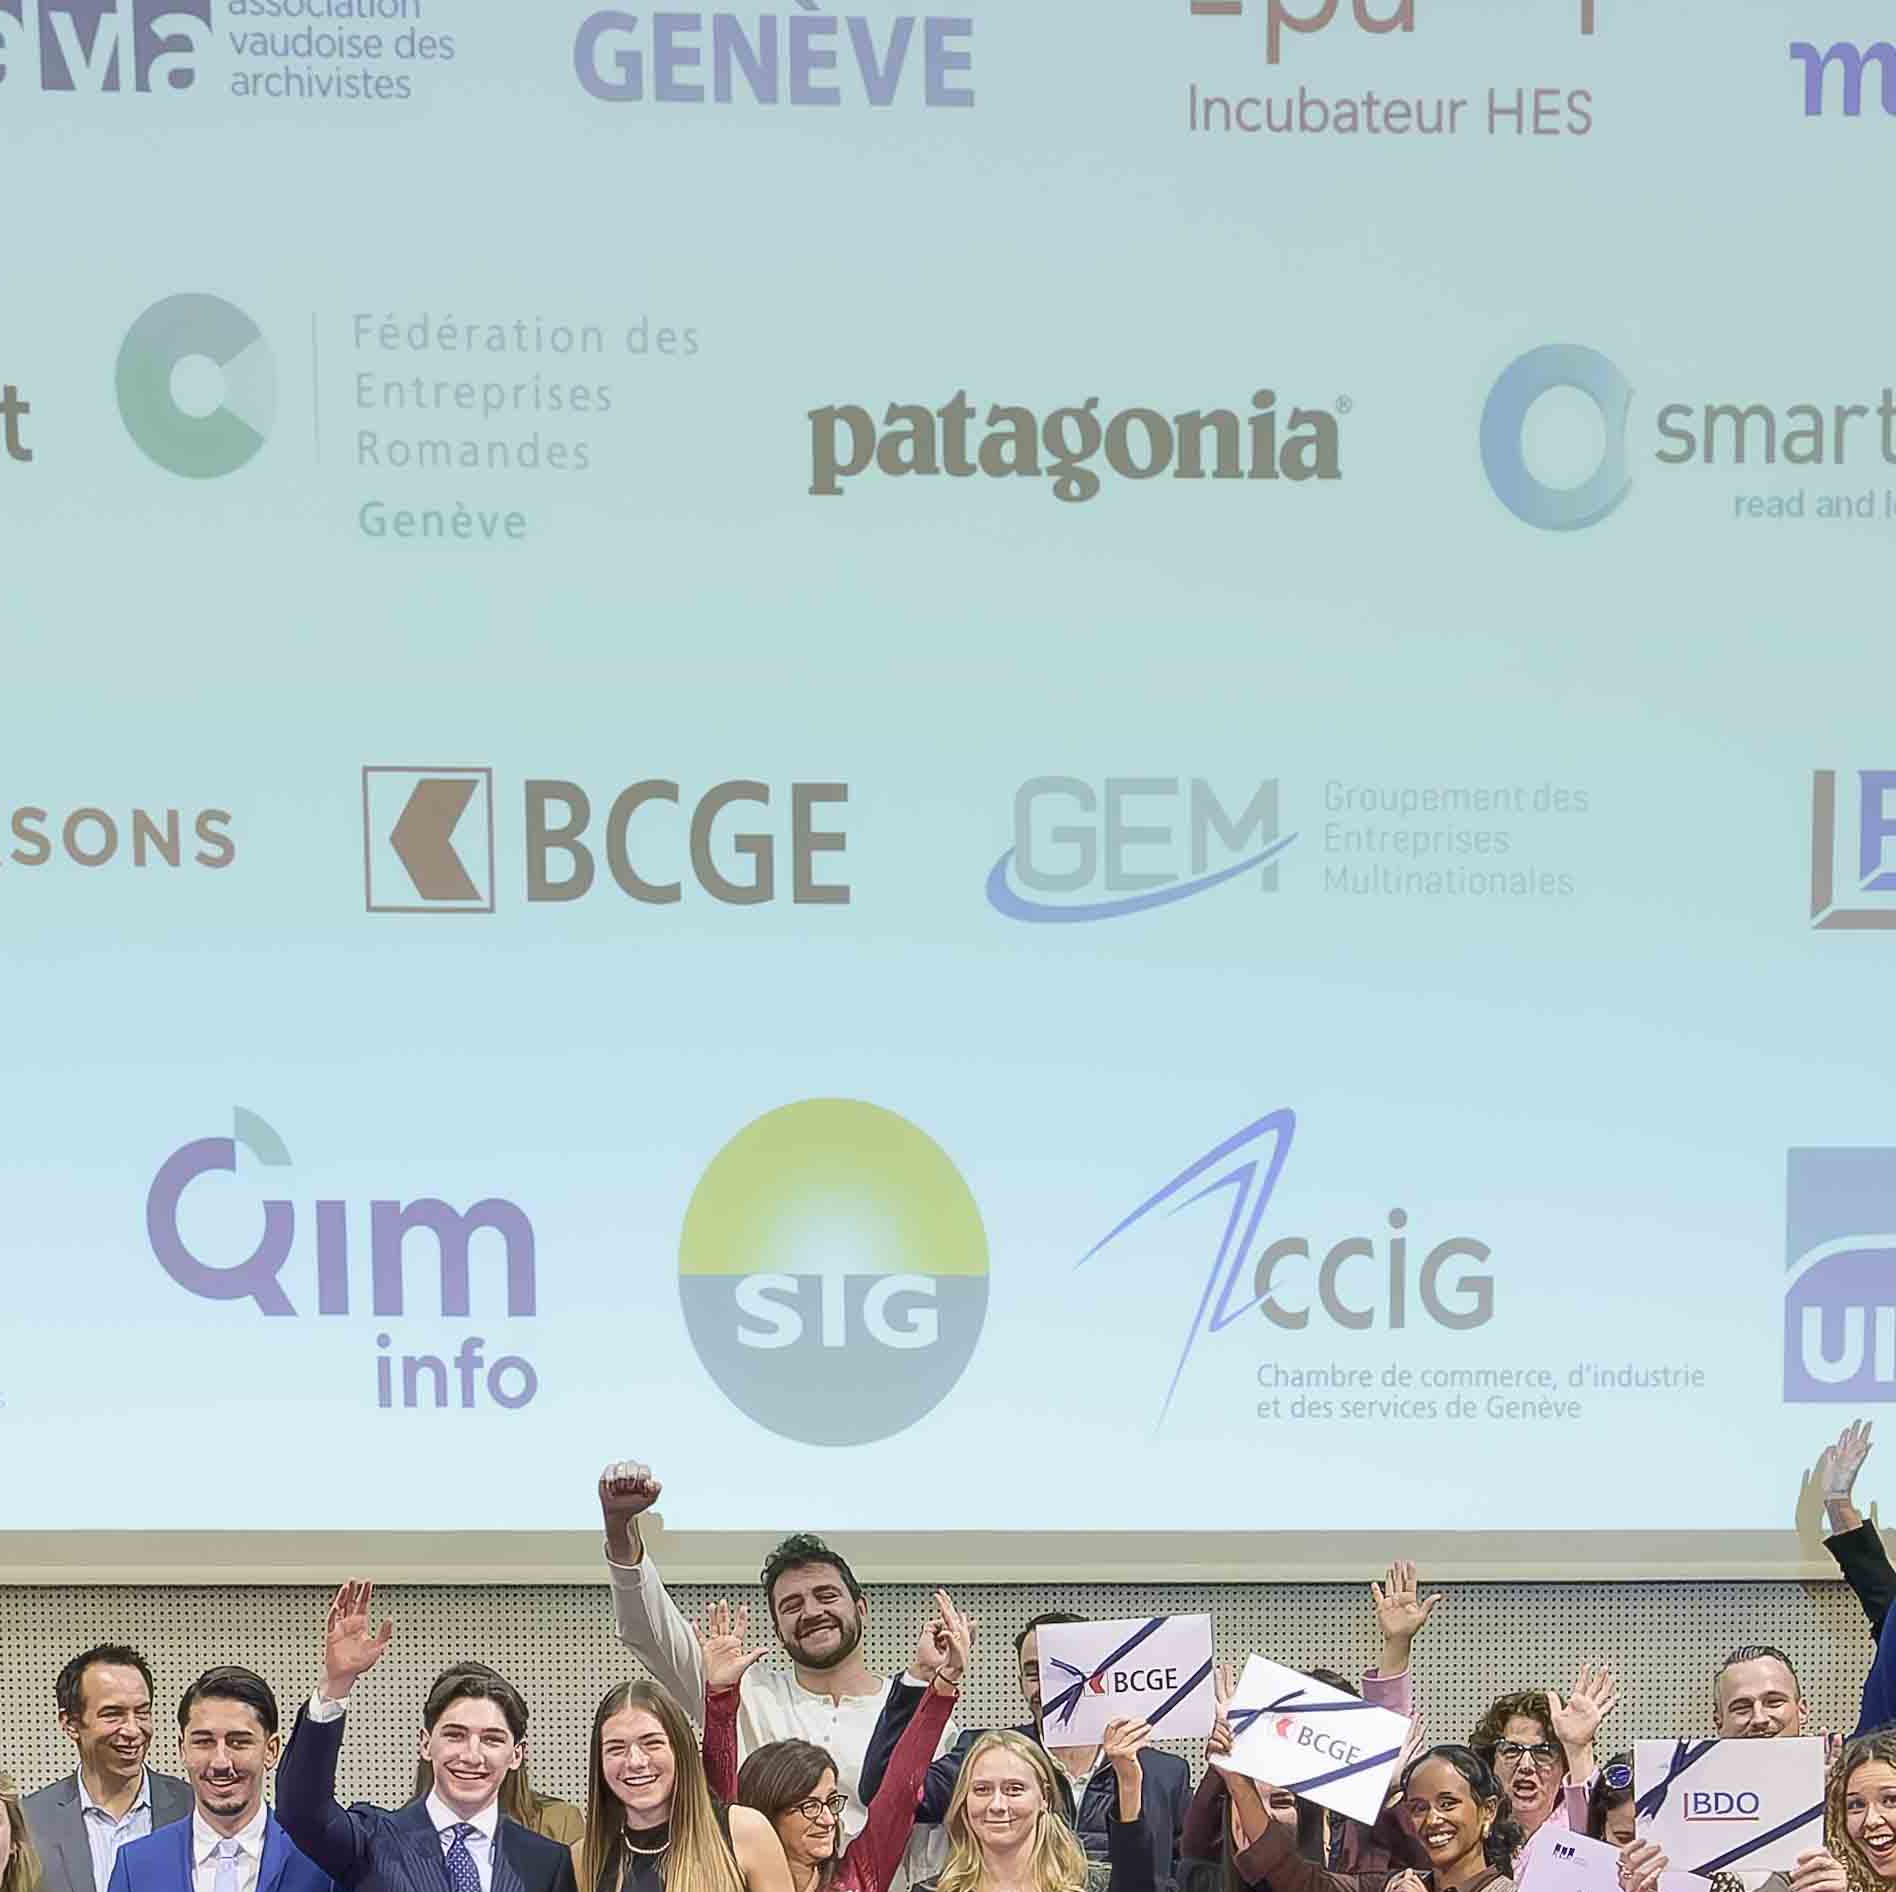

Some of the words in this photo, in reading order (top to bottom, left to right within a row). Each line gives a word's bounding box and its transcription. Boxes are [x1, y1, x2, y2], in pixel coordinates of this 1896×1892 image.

[230, 25, 384, 60] vaudoise
[394, 26, 456, 61] des
[230, 66, 412, 101] archivistes
[1189, 84, 1468, 136] Incubateur
[1487, 88, 1595, 136] HES
[352, 311, 604, 355] Fédération
[625, 314, 701, 358] des
[354, 372, 614, 418] Entreprises
[354, 430, 592, 474] Romandes
[358, 499, 529, 544] Genève
[1732, 488, 1807, 521] read
[1814, 488, 1875, 522] and
[1323, 778, 1518, 820] Groupement
[1524, 778, 1590, 816] des
[525, 780, 852, 906] BCGE
[1009, 774, 1282, 894] GEM
[1323, 818, 1511, 862] Entreprises
[1323, 859, 1574, 900] Multinationales
[733, 1273, 941, 1350] SIG
[373, 1335, 540, 1412] info
[1255, 1363, 1374, 1389] Chambre
[1382, 1363, 1412, 1389] de
[1420, 1368, 1559, 1394] commerce,
[1567, 1363, 1706, 1389] d'industrie
[1255, 1395, 1281, 1420] et
[1290, 1394, 1333, 1420] des
[1340, 1395, 1439, 1420] services
[1448, 1394, 1478, 1420] de
[1485, 1394, 1583, 1420] Genève
[1114, 1667, 1178, 1693] BCGE
[1693, 1791, 1760, 1815] BDO
